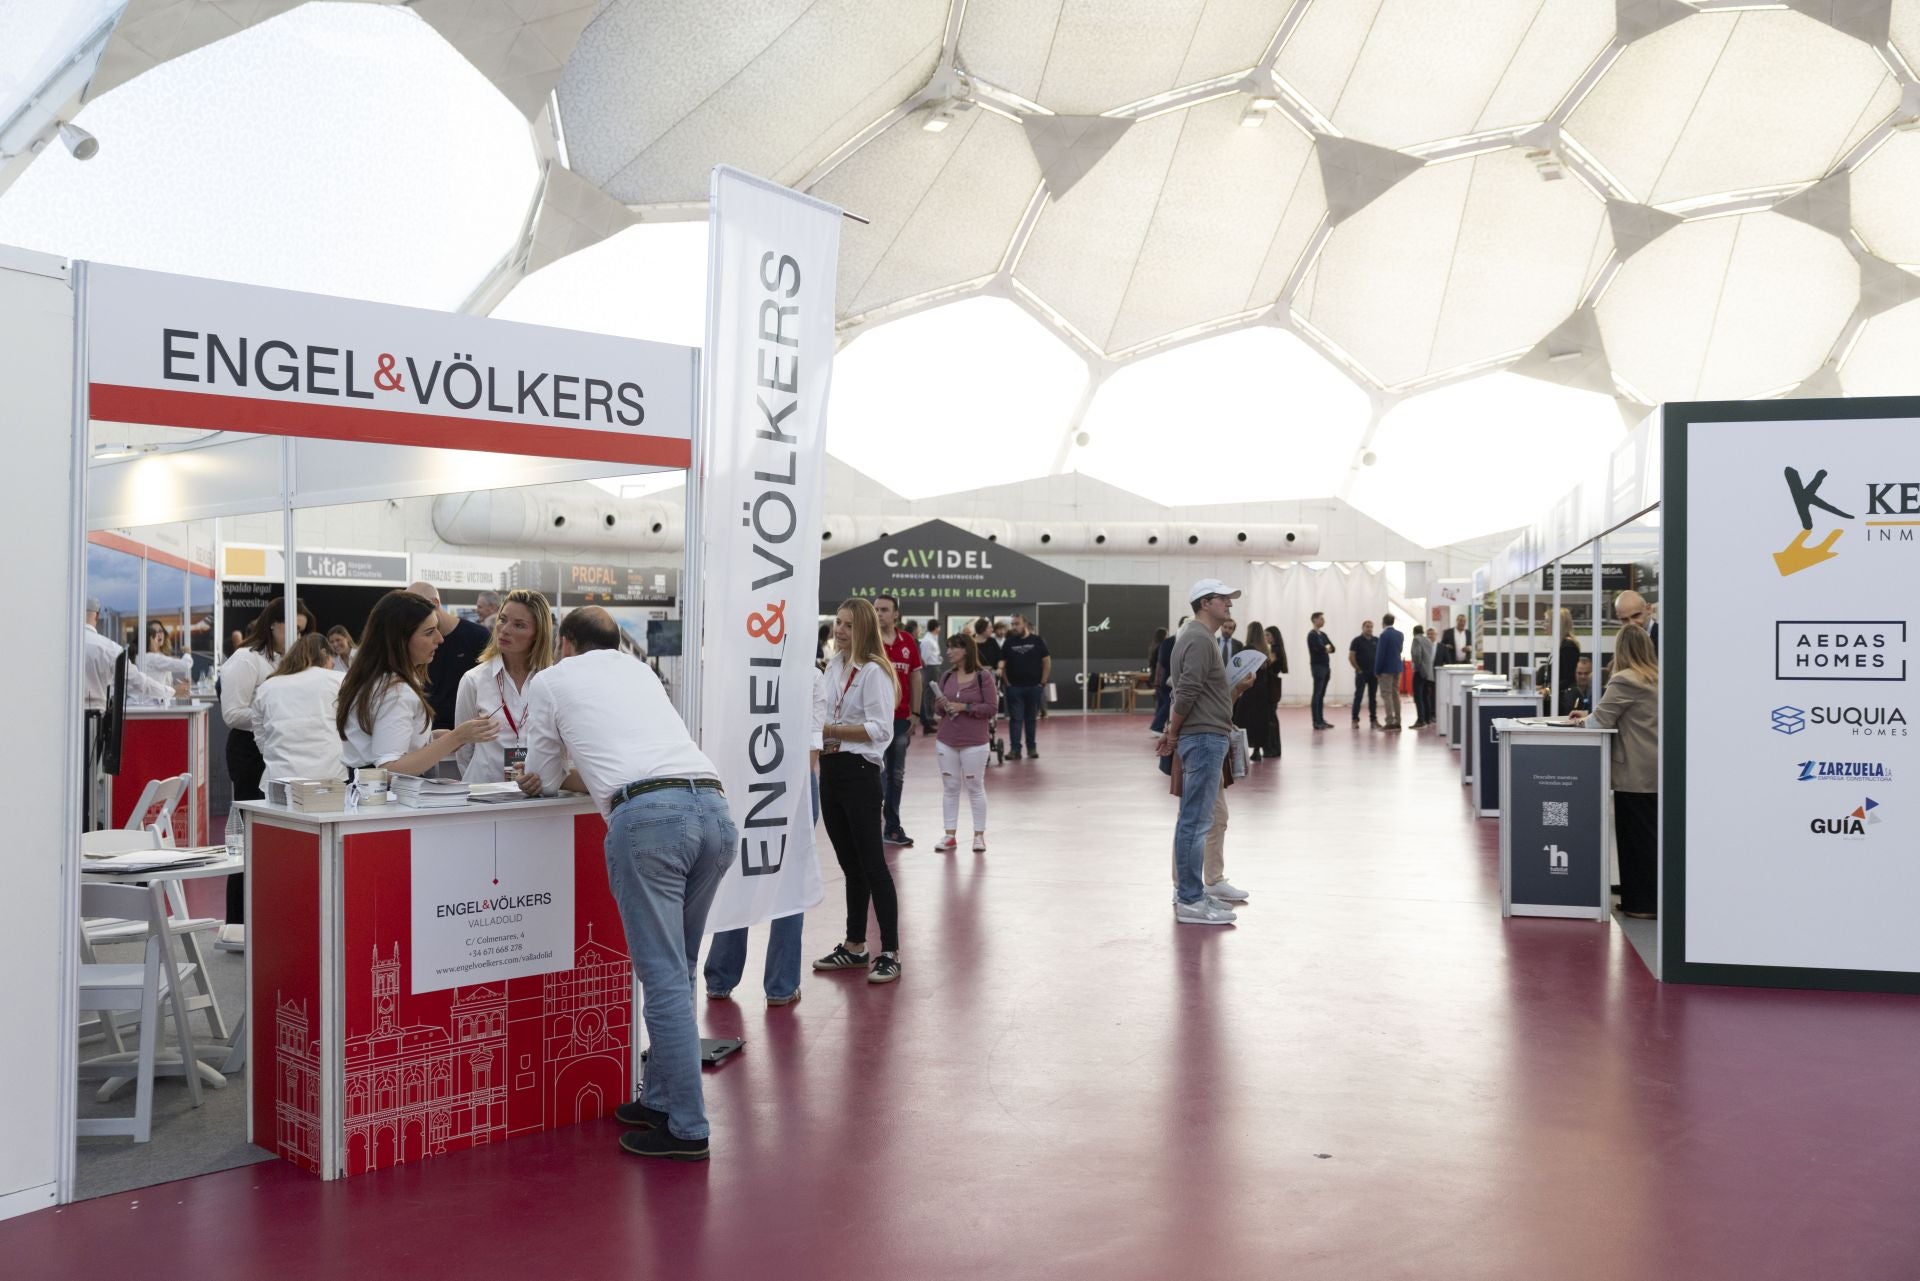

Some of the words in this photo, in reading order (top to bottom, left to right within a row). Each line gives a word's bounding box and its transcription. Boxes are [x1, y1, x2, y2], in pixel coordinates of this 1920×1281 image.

[163, 328, 645, 427] ENGEL&VÖLKERS
[883, 549, 992, 569] CAVIDEL
[420, 569, 451, 582] TERRAZAS
[467, 571, 493, 583] VICTORIA
[571, 565, 617, 585] PROFAL
[252, 583, 272, 595] legal
[852, 587, 876, 597] LAS
[882, 587, 925, 598] CASAS
[931, 588, 960, 598] BIEN
[966, 588, 1017, 598] HECHAS
[1796, 634, 1885, 648] AEDAS
[1796, 653, 1885, 667] HOMES
[1811, 706, 1907, 727] SUQUIA
[1852, 728, 1908, 736] HOMES
[1818, 762, 1884, 776] ZARZUELA
[1810, 816, 1865, 834] GUÍA
[436, 892, 552, 918] ENGEL&VÖLKERS
[468, 913, 523, 928] VALLADOLID
[468, 949, 481, 957] +34
[483, 947, 494, 956] 671
[510, 943, 523, 952] 278
